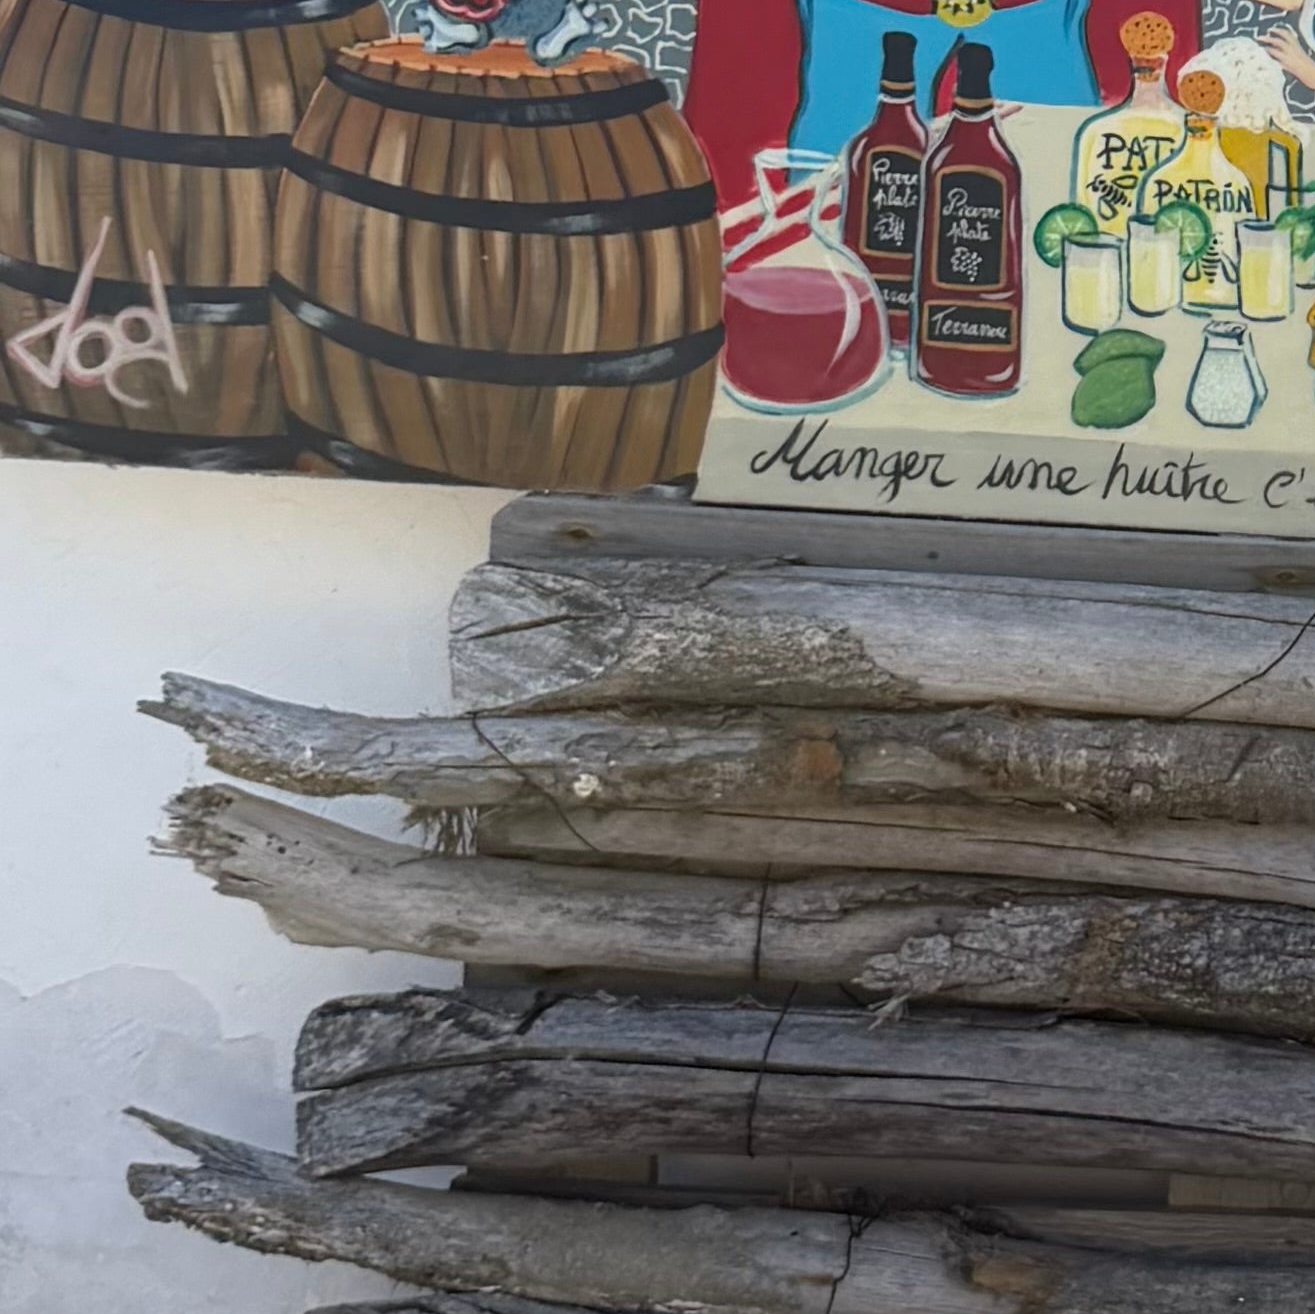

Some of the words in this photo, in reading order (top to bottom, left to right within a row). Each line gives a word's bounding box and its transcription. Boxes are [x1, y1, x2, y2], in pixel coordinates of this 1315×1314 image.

[1096, 133, 1175, 172] PAT
[751, 418, 957, 506] Manger
[976, 452, 1096, 497] une
